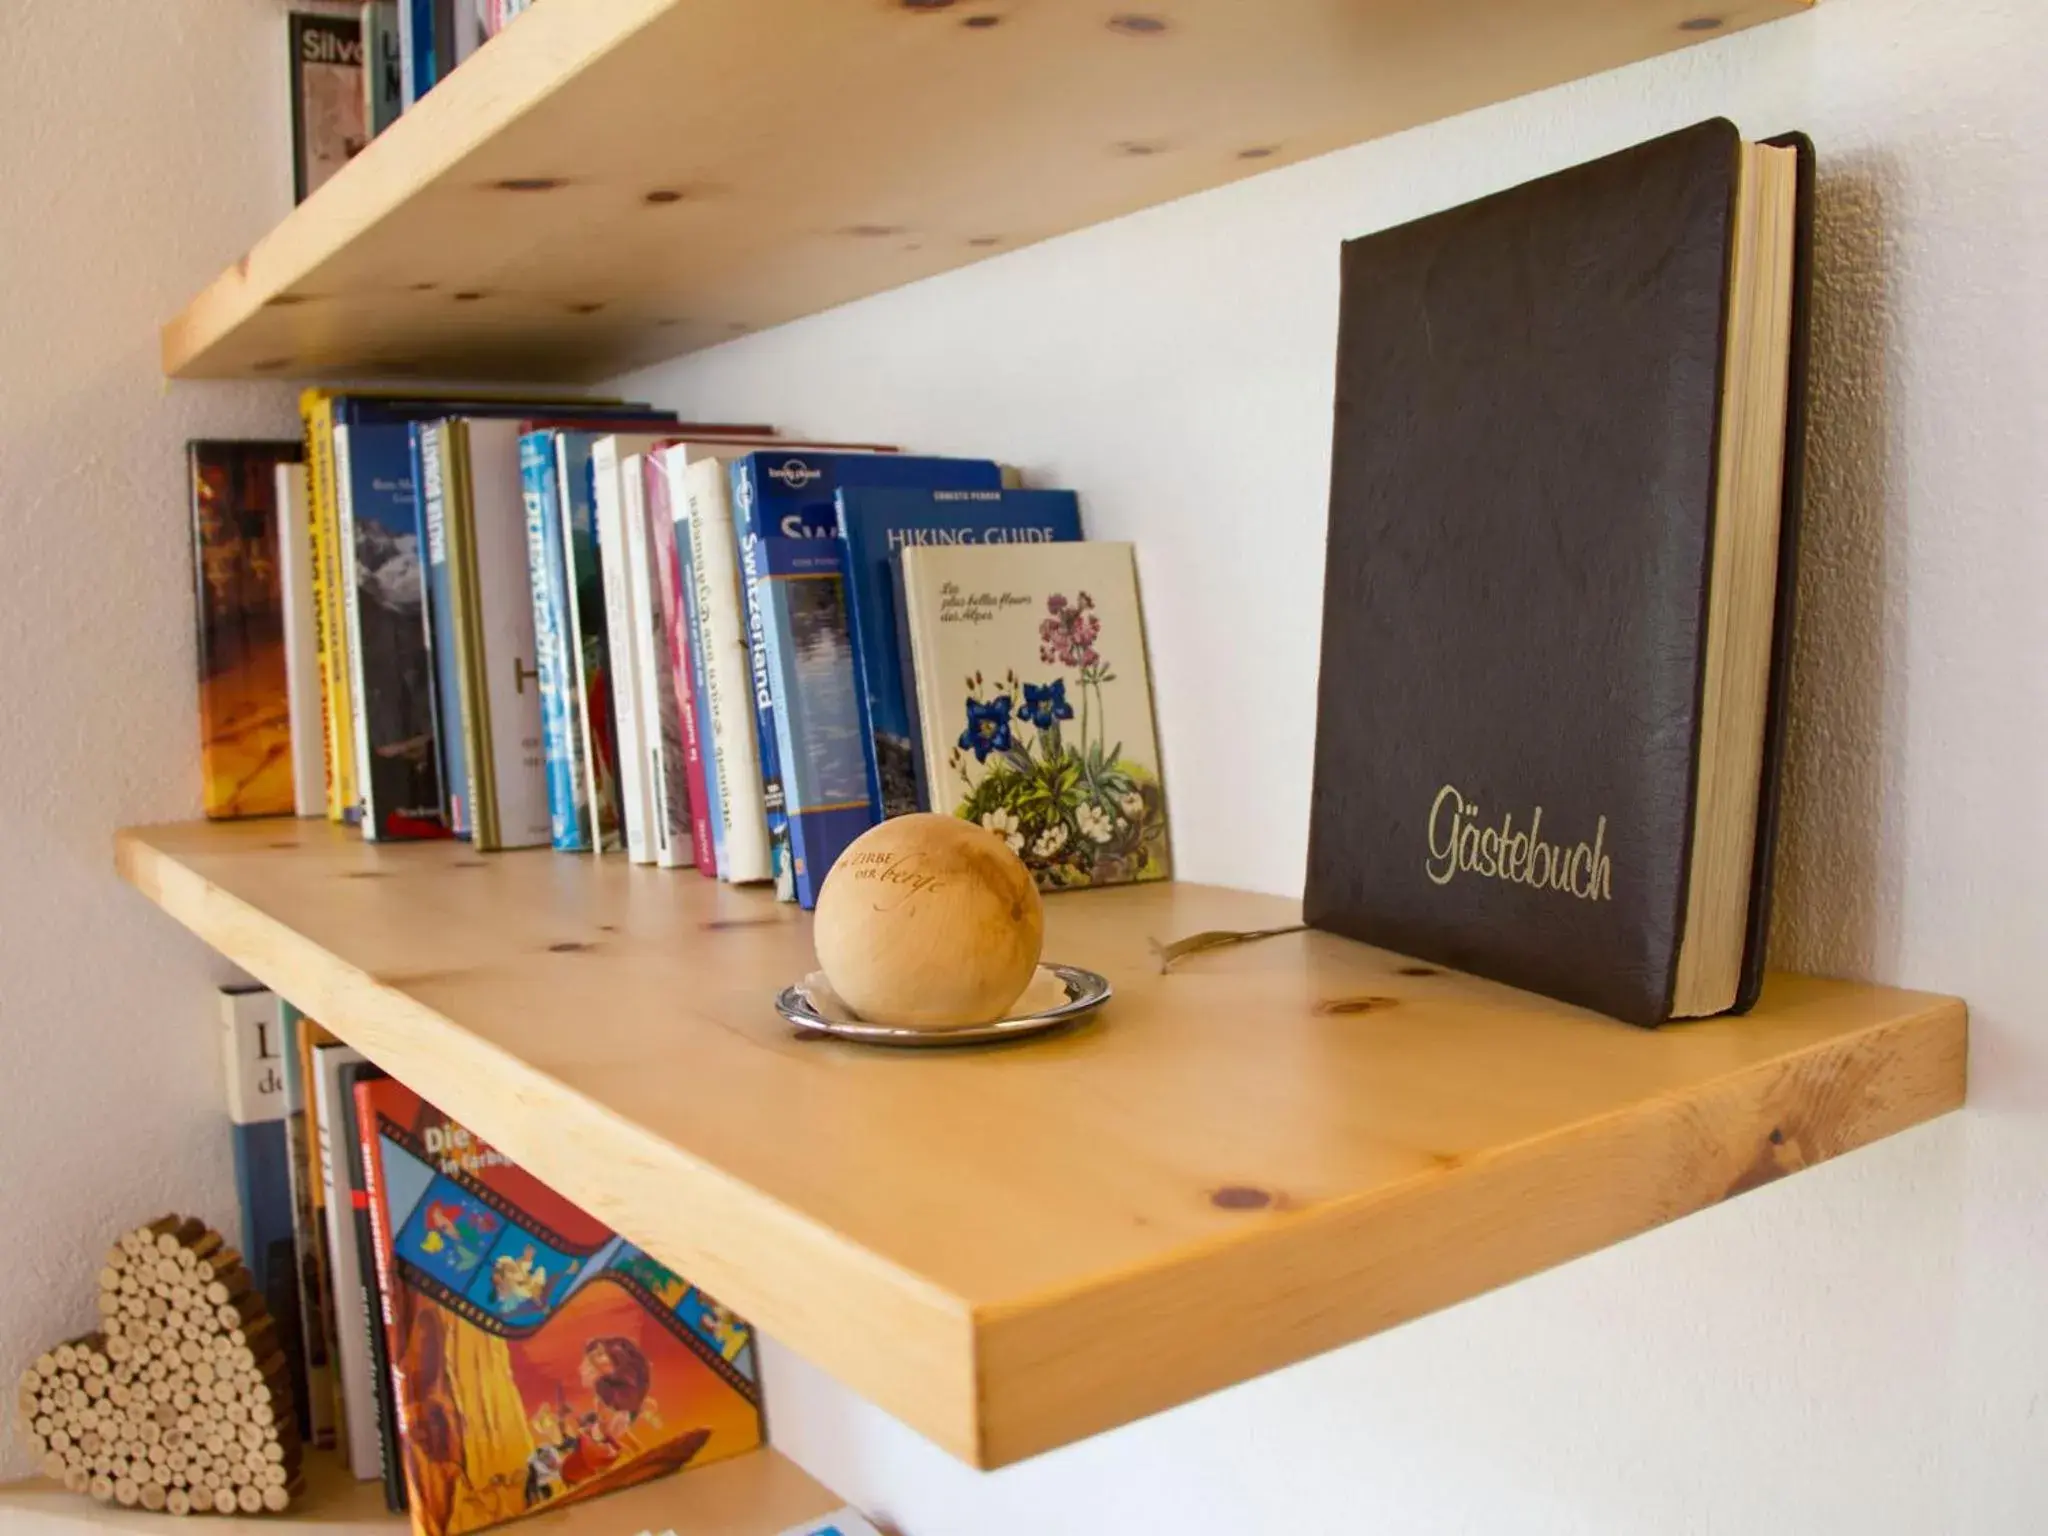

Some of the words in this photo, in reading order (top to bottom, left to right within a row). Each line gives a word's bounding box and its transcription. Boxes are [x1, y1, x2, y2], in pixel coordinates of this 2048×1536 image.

[887, 527, 975, 550] HIKING
[940, 596, 966, 613] plus
[967, 592, 998, 607] belles
[741, 532, 774, 709] Switzerland
[1425, 784, 1612, 902] Gästebuch
[852, 852, 894, 866] ZIRBE
[424, 1124, 470, 1154] Die
